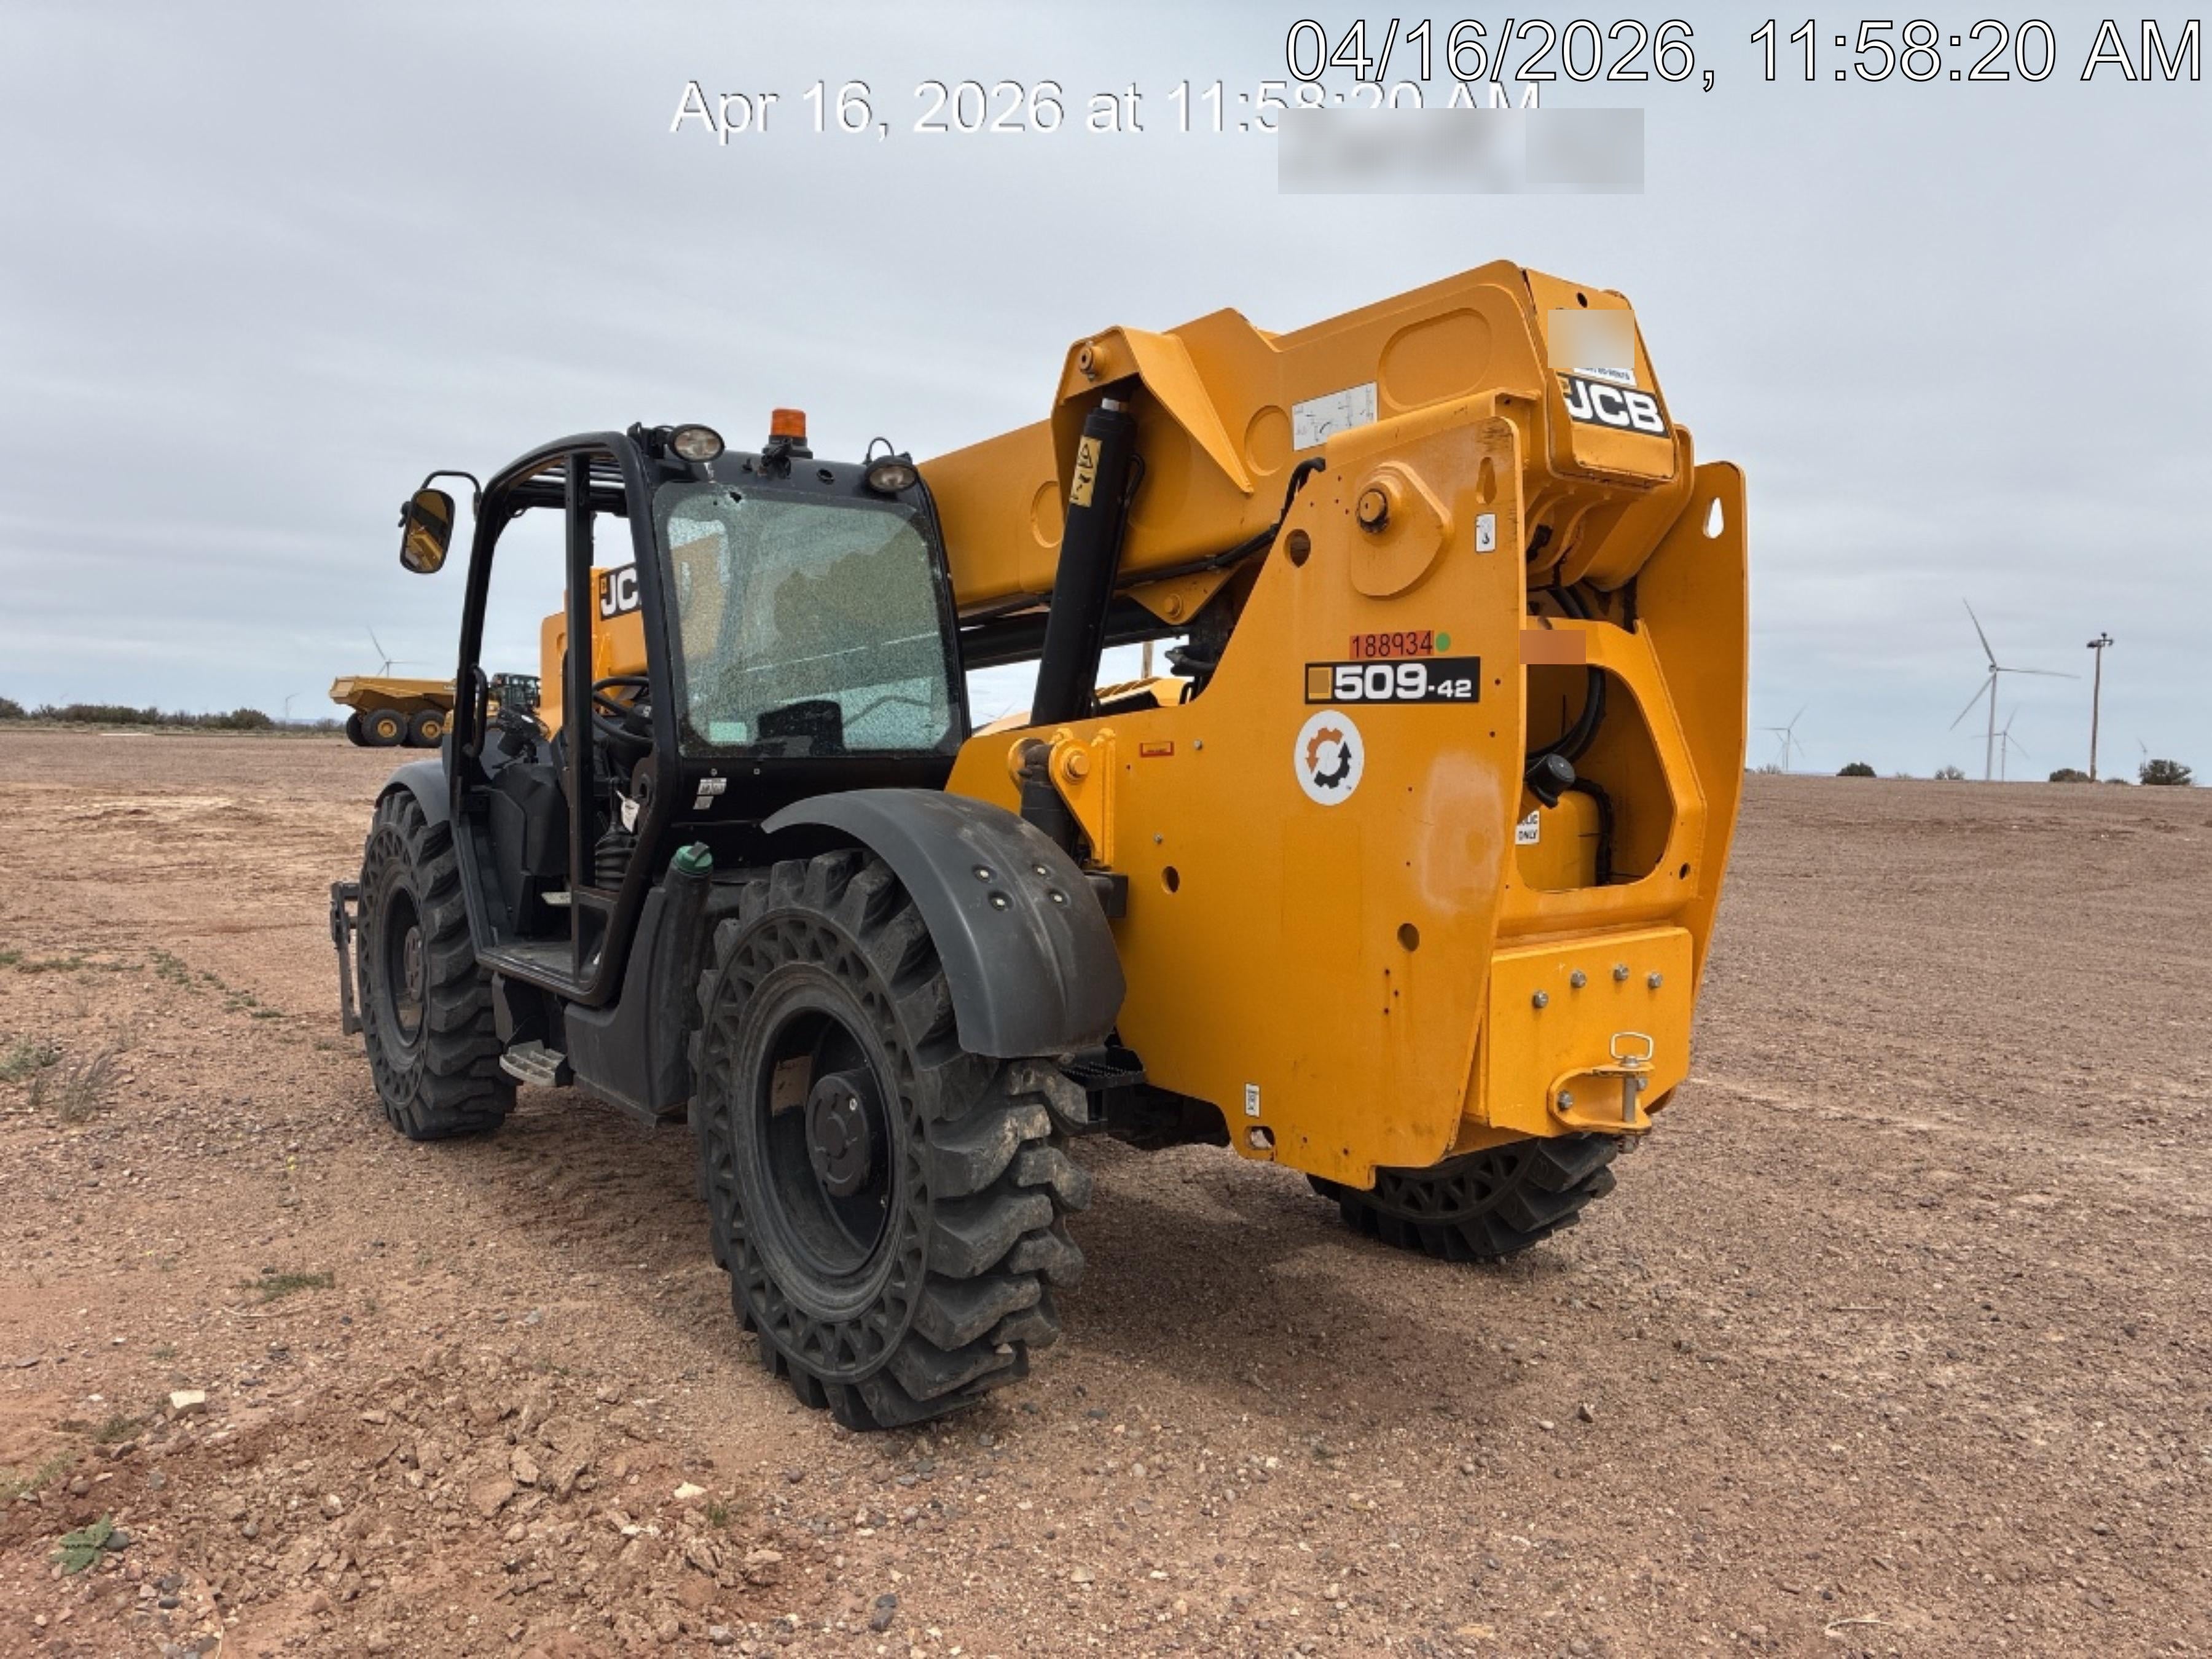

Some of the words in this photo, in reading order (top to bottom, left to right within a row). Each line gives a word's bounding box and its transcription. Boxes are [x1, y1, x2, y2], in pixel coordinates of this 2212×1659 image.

[1563, 380, 1664, 432] JCB
[600, 567, 641, 616] JC
[1352, 630, 1432, 658] 188934
[1333, 662, 1472, 700] 509-42
